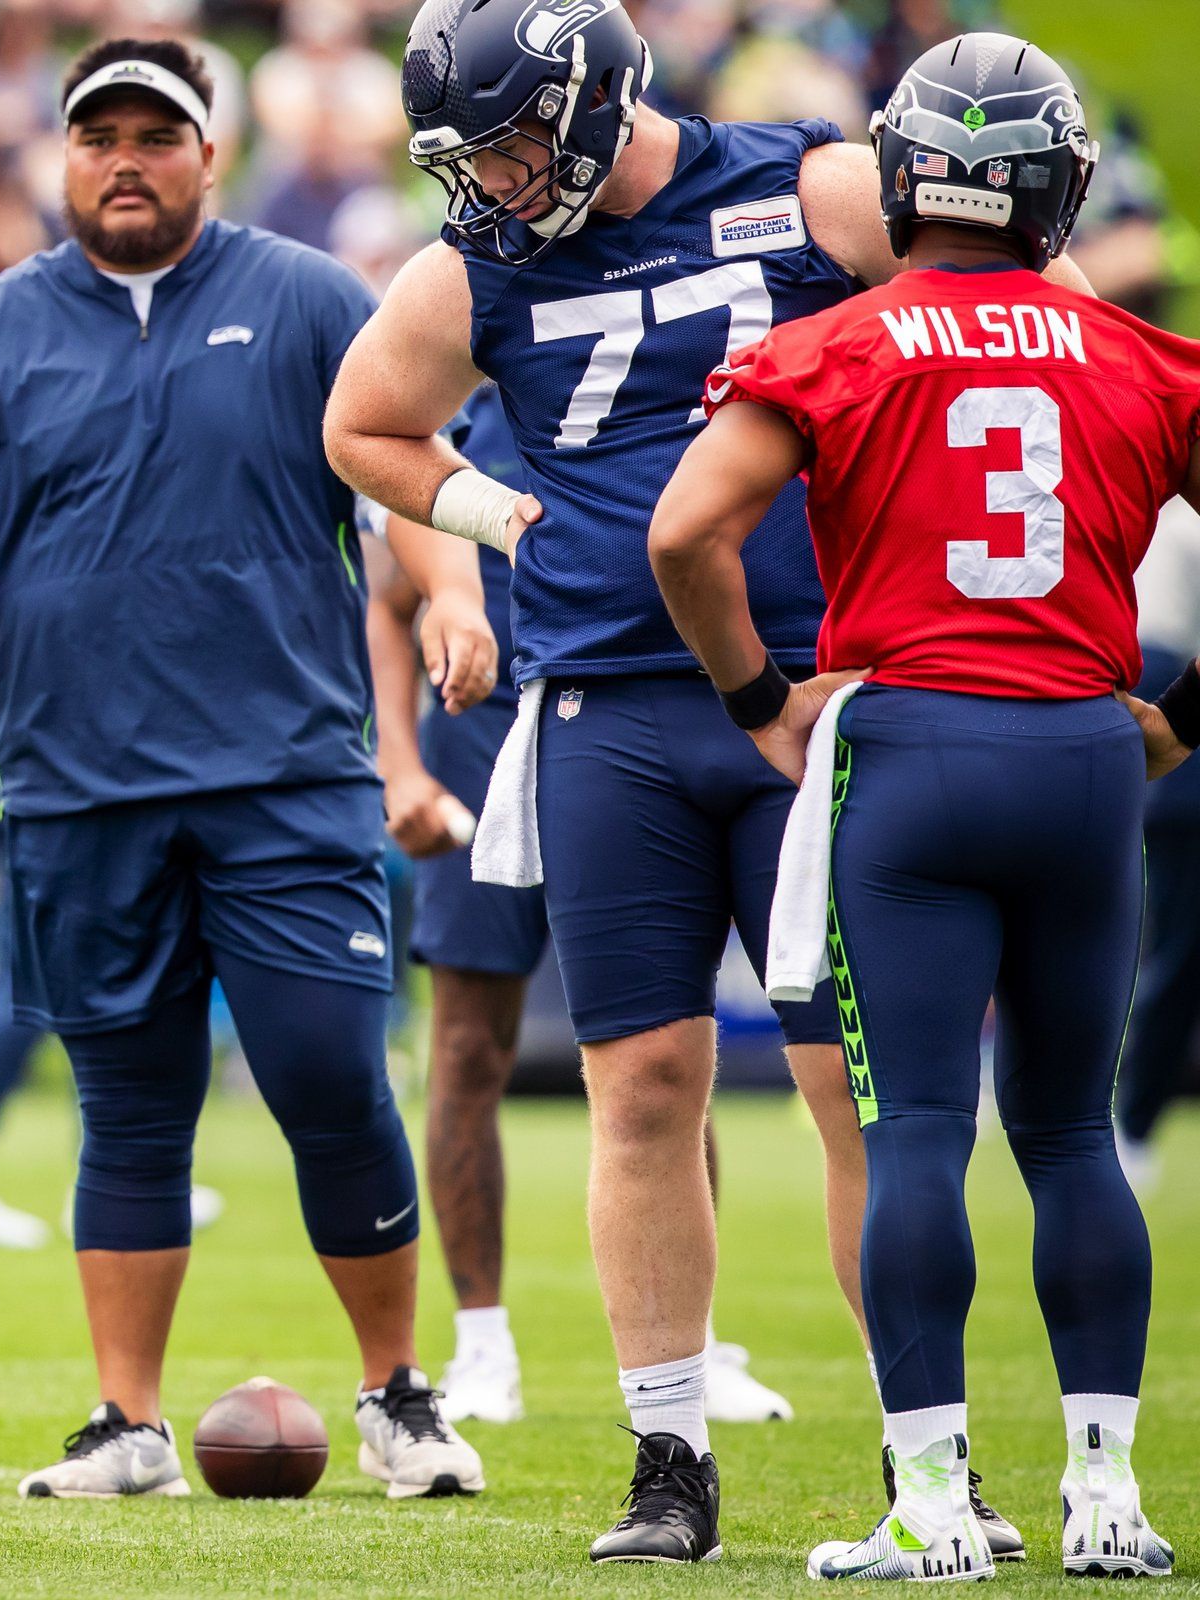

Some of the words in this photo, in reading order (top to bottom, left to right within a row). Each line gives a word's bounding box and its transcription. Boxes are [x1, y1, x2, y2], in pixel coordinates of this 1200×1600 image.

[924, 194, 1005, 211] SEATTLE
[721, 224, 761, 234] AMERICAN
[763, 217, 791, 228] FAMILY
[726, 226, 787, 240] INSURANCE
[603, 255, 677, 281] SEAHAWKS
[879, 304, 1087, 364] WILSON
[531, 260, 773, 449] 77
[946, 386, 1065, 600] 3
